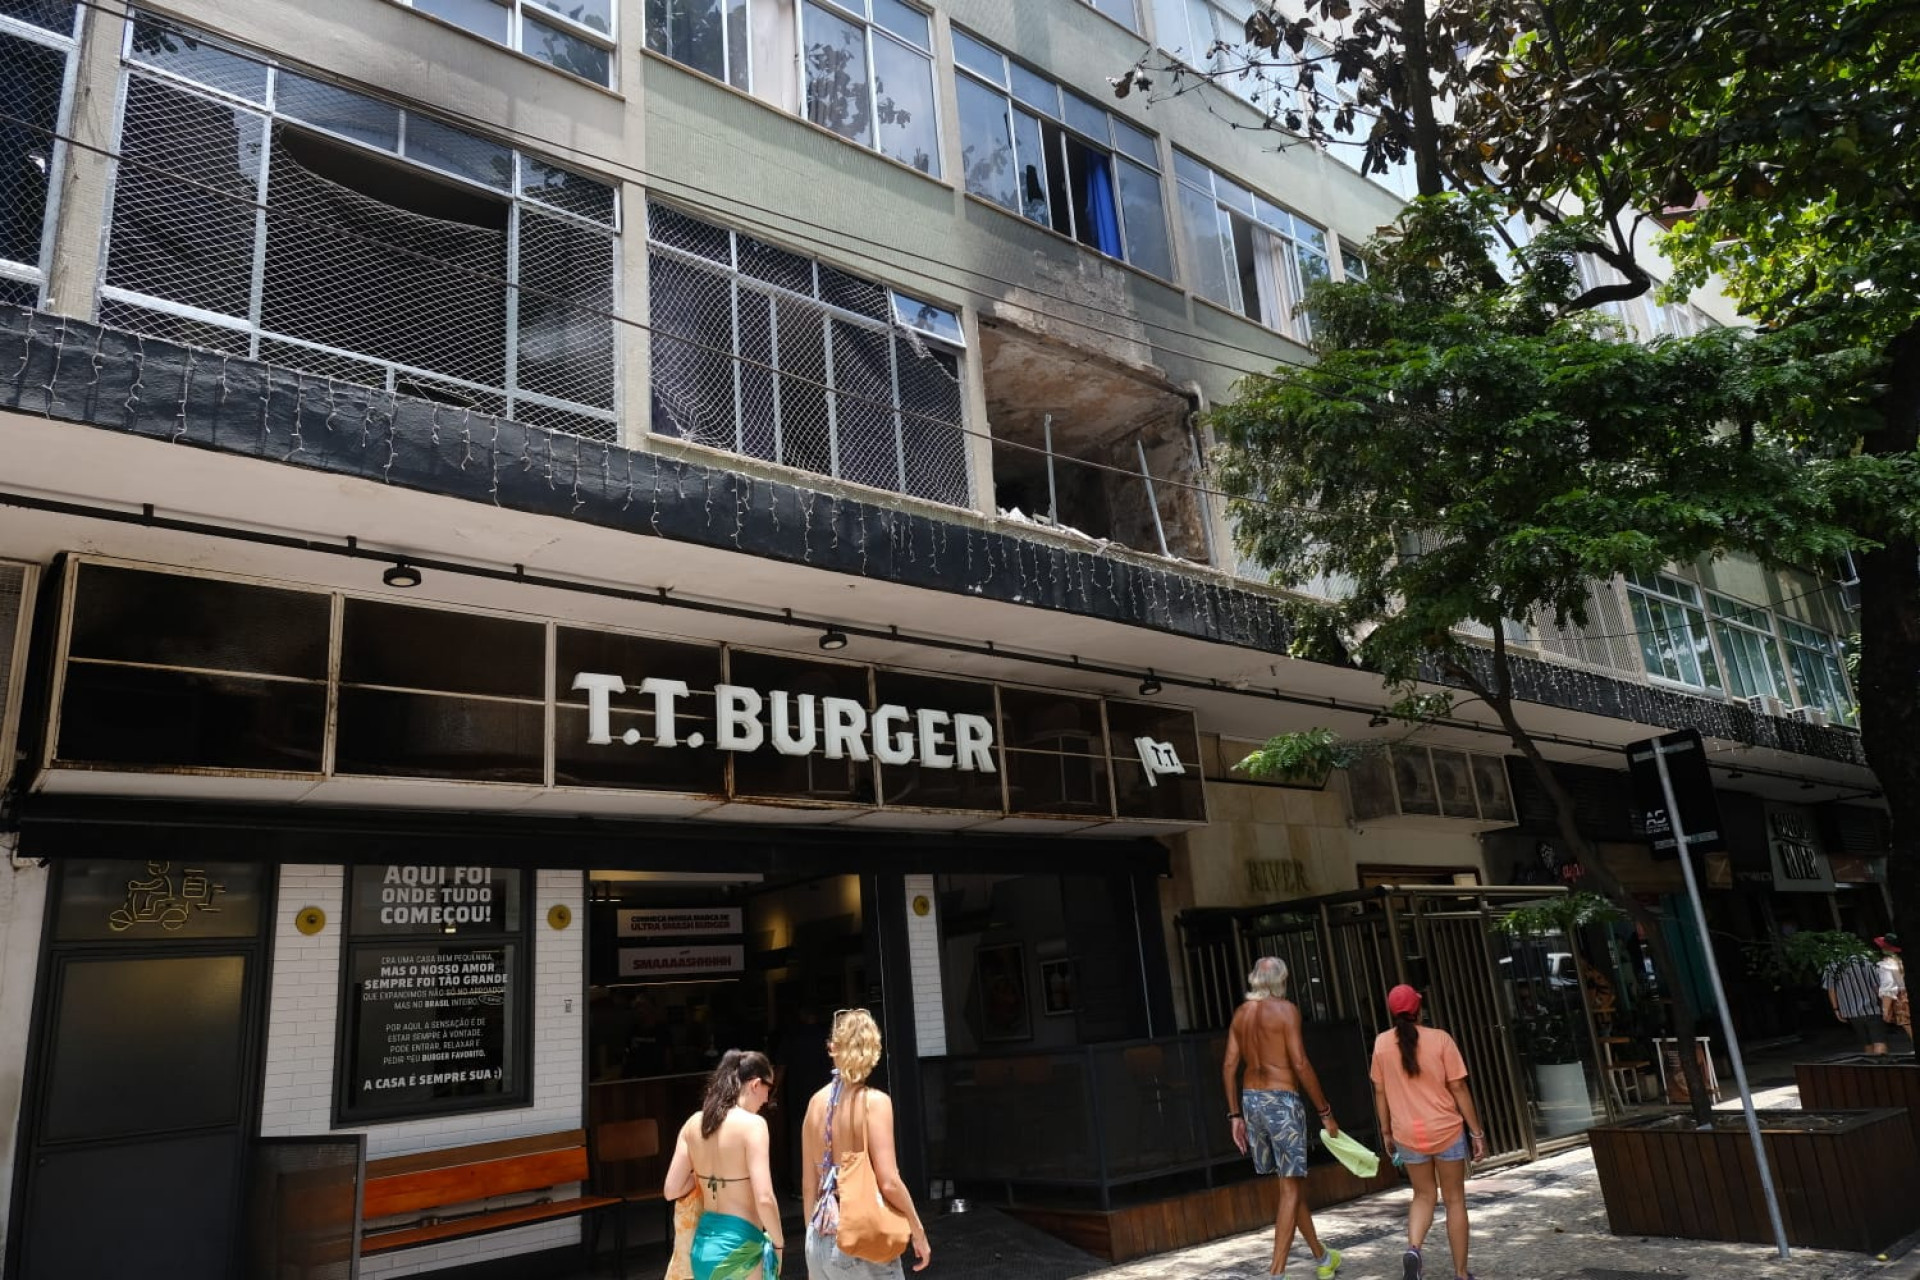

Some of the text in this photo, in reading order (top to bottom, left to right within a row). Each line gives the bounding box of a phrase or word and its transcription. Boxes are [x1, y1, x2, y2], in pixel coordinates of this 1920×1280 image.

[384, 865, 491, 887] AQUI FOI
[1244, 858, 1311, 892] RIVER
[382, 887, 492, 903] ONDE TUDO
[380, 906, 491, 925] COMEÇOU!
[631, 922, 660, 931] ULTRA
[380, 963, 495, 977] MAS O NOSSO AMOR
[364, 973, 508, 990] SEMPRE FOI TÃO GRANDE
[394, 1001, 411, 1010] MAS
[412, 1000, 423, 1009] NO
[424, 1000, 450, 1008] BRASIL
[386, 1023, 400, 1032] POR
[431, 1018, 469, 1029] SENSAÇÃO
[387, 1033, 411, 1042] ESTAR
[412, 1031, 441, 1041] SEMPRE
[390, 1043, 410, 1053] PODE
[443, 1040, 475, 1050] RELAXAR
[383, 1055, 404, 1065] PEDIR
[421, 1053, 450, 1063] BURGER
[363, 1079, 373, 1090] A
[375, 1077, 406, 1089] CASA
[408, 1072, 417, 1086] É
[419, 1070, 467, 1085] SEMPRE
[469, 1069, 491, 1080] SUA
